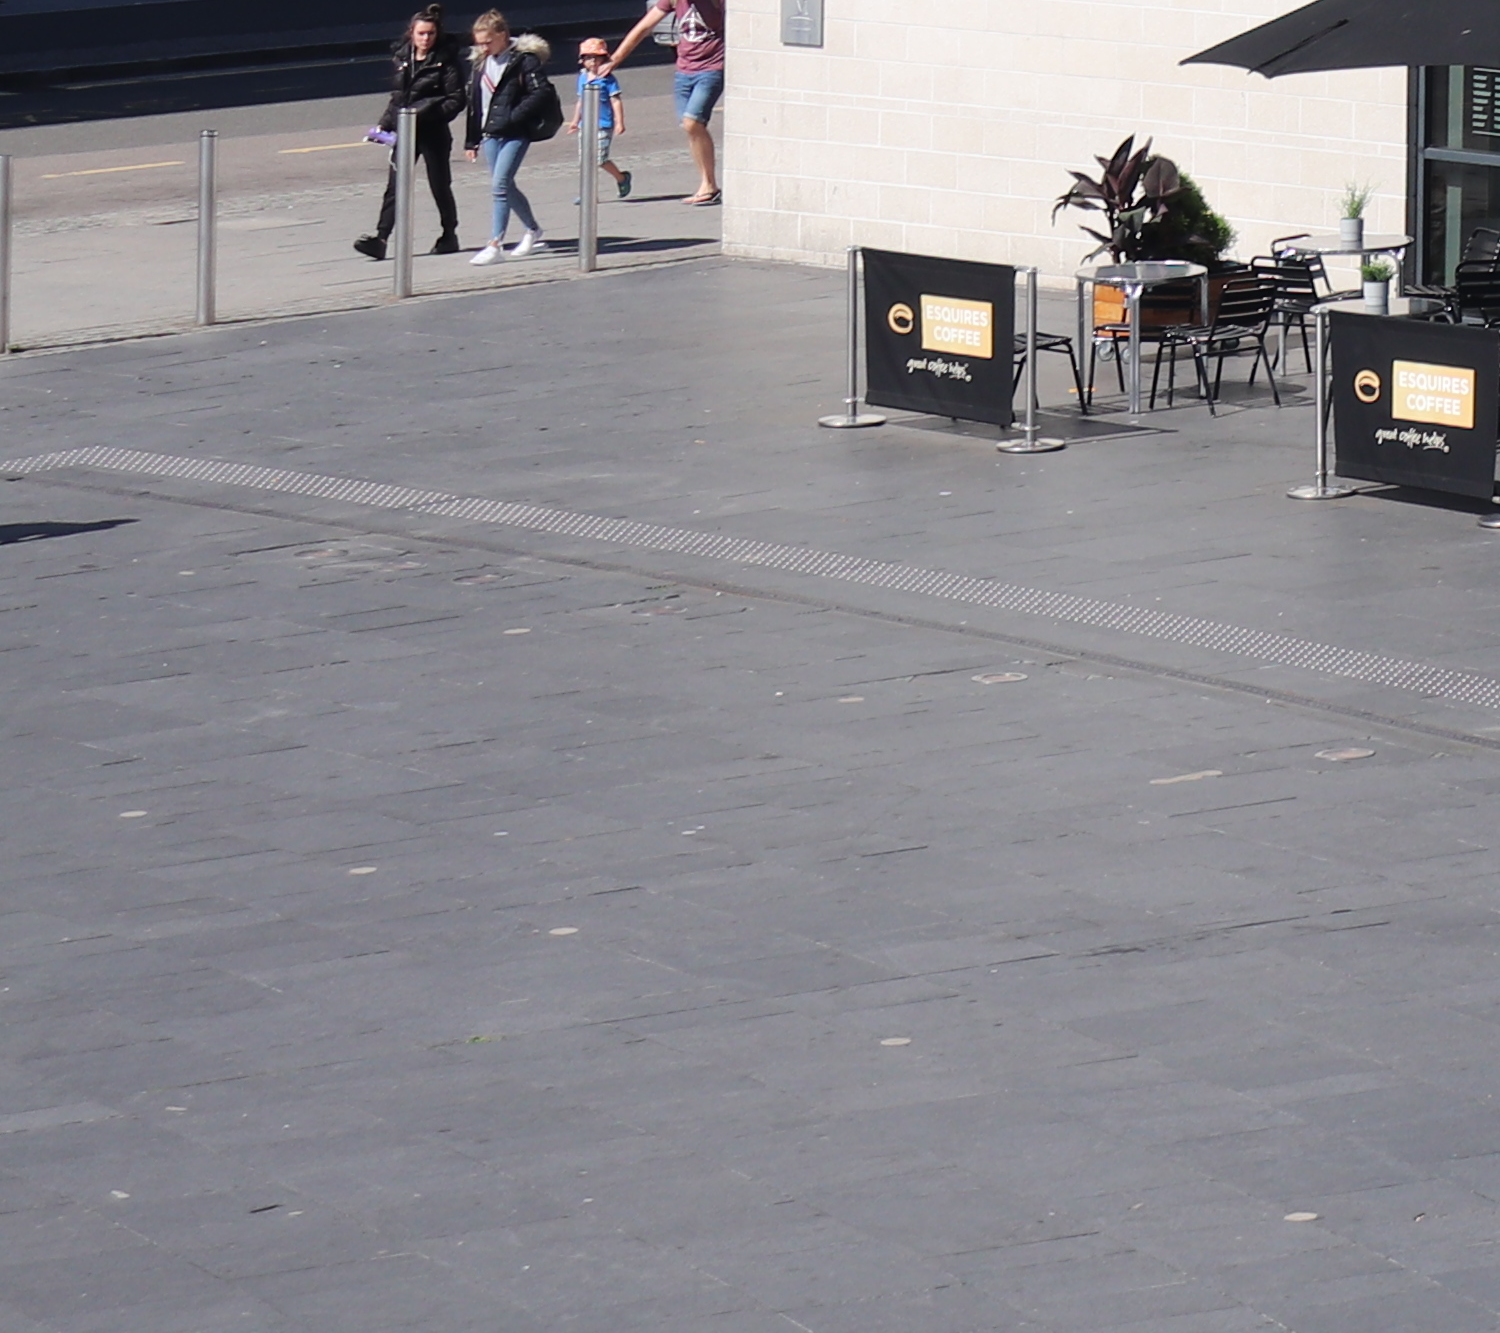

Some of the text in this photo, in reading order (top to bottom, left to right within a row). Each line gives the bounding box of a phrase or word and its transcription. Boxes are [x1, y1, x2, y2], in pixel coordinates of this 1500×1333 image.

[926, 304, 988, 327] ESQUIRES
[934, 325, 981, 346] COFFEE
[1399, 371, 1469, 395] ESQUIRES
[1406, 395, 1461, 416] COFFEE
